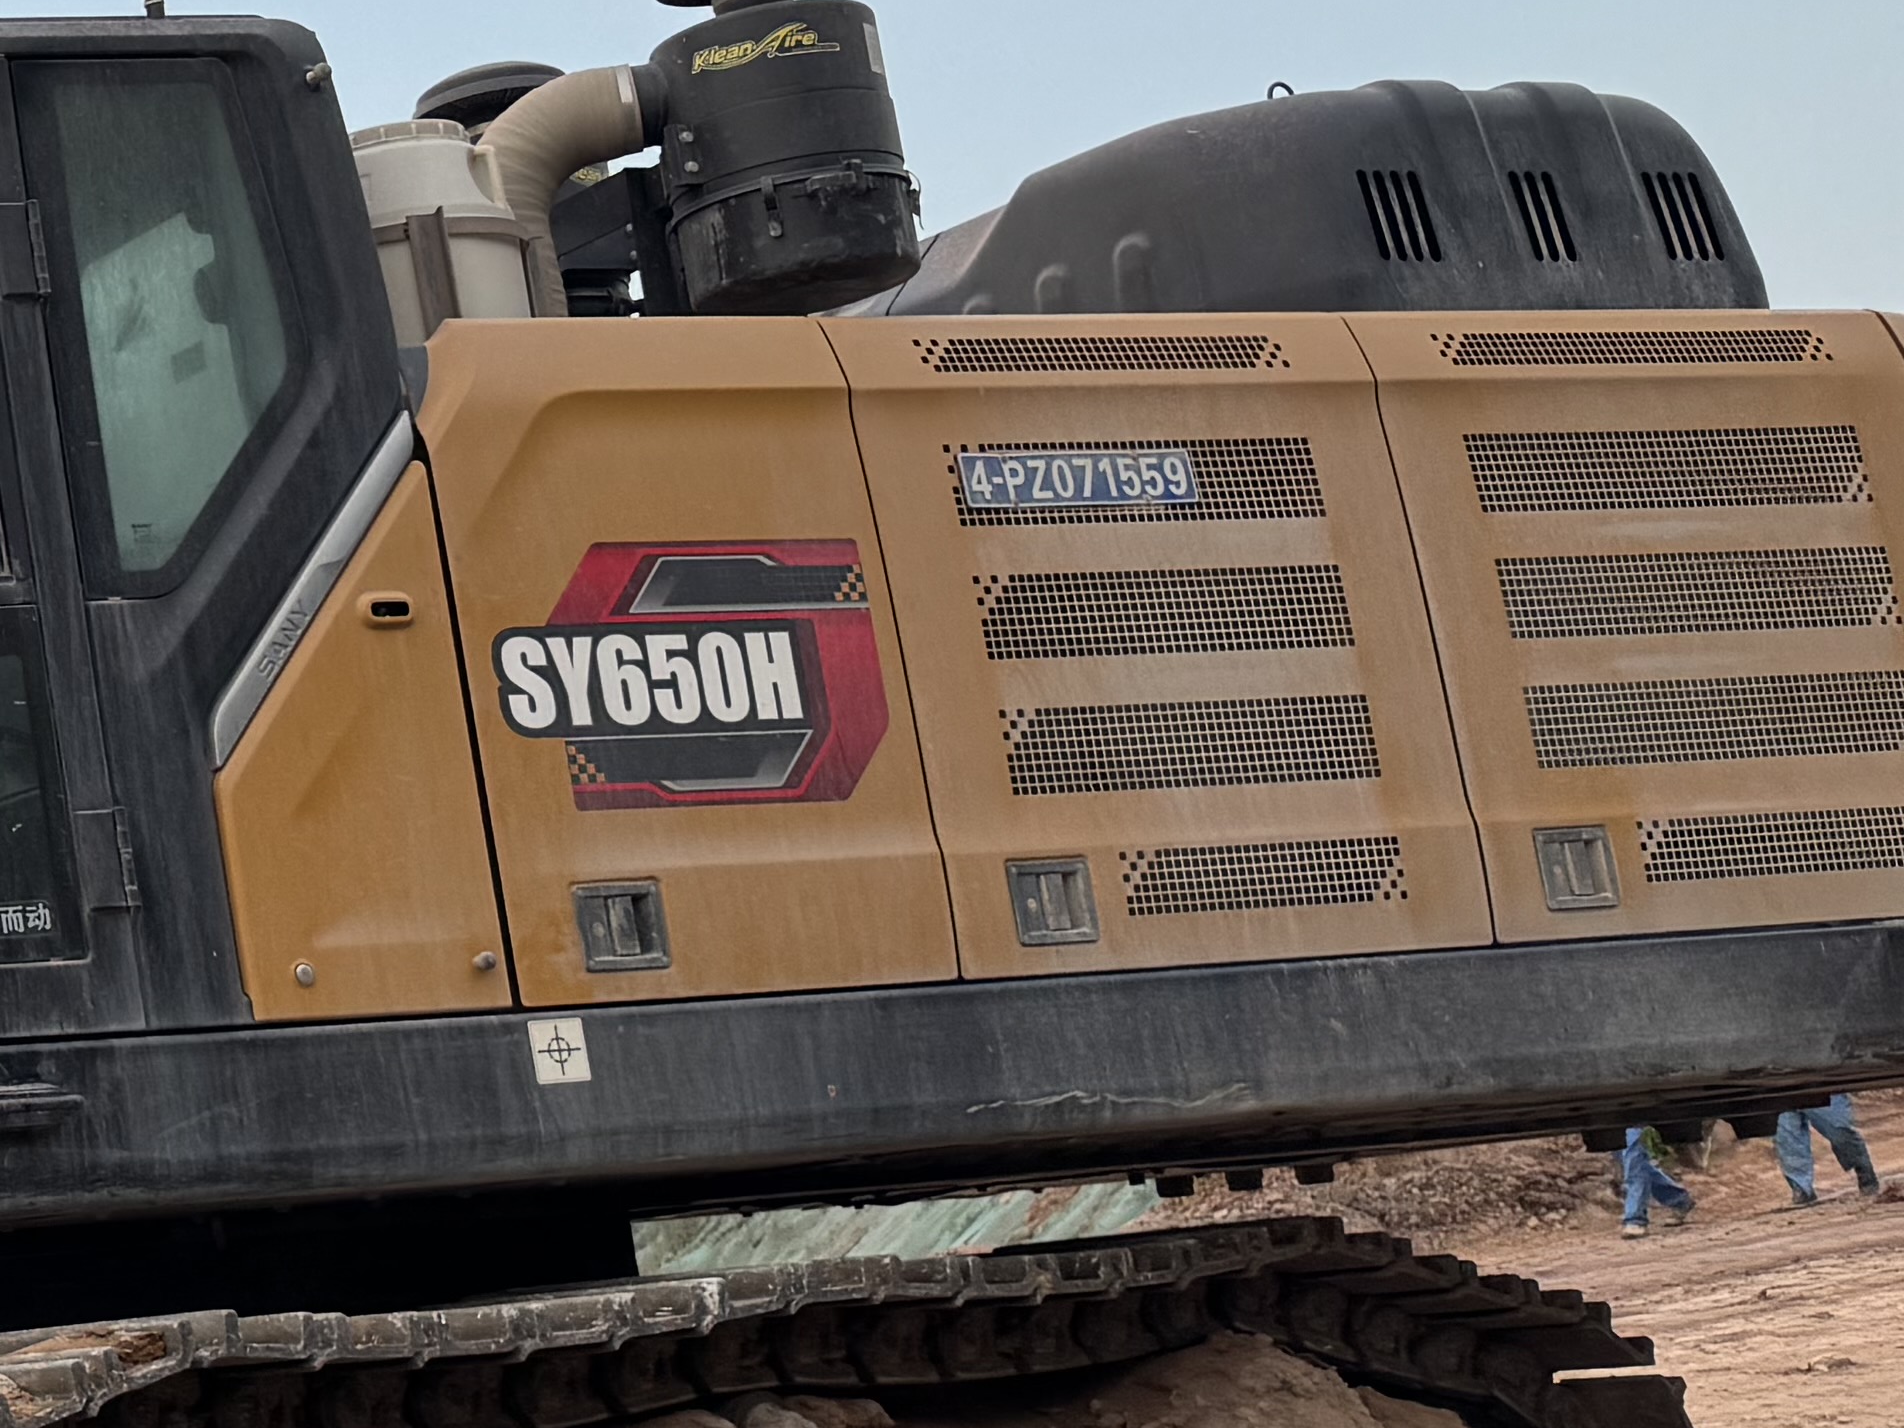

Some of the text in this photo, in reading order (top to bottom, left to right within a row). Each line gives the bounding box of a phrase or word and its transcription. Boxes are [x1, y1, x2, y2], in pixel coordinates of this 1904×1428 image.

[970, 456, 1189, 501] 4-PZ071559
[257, 597, 310, 682] SANY
[500, 630, 805, 729] SY650H
